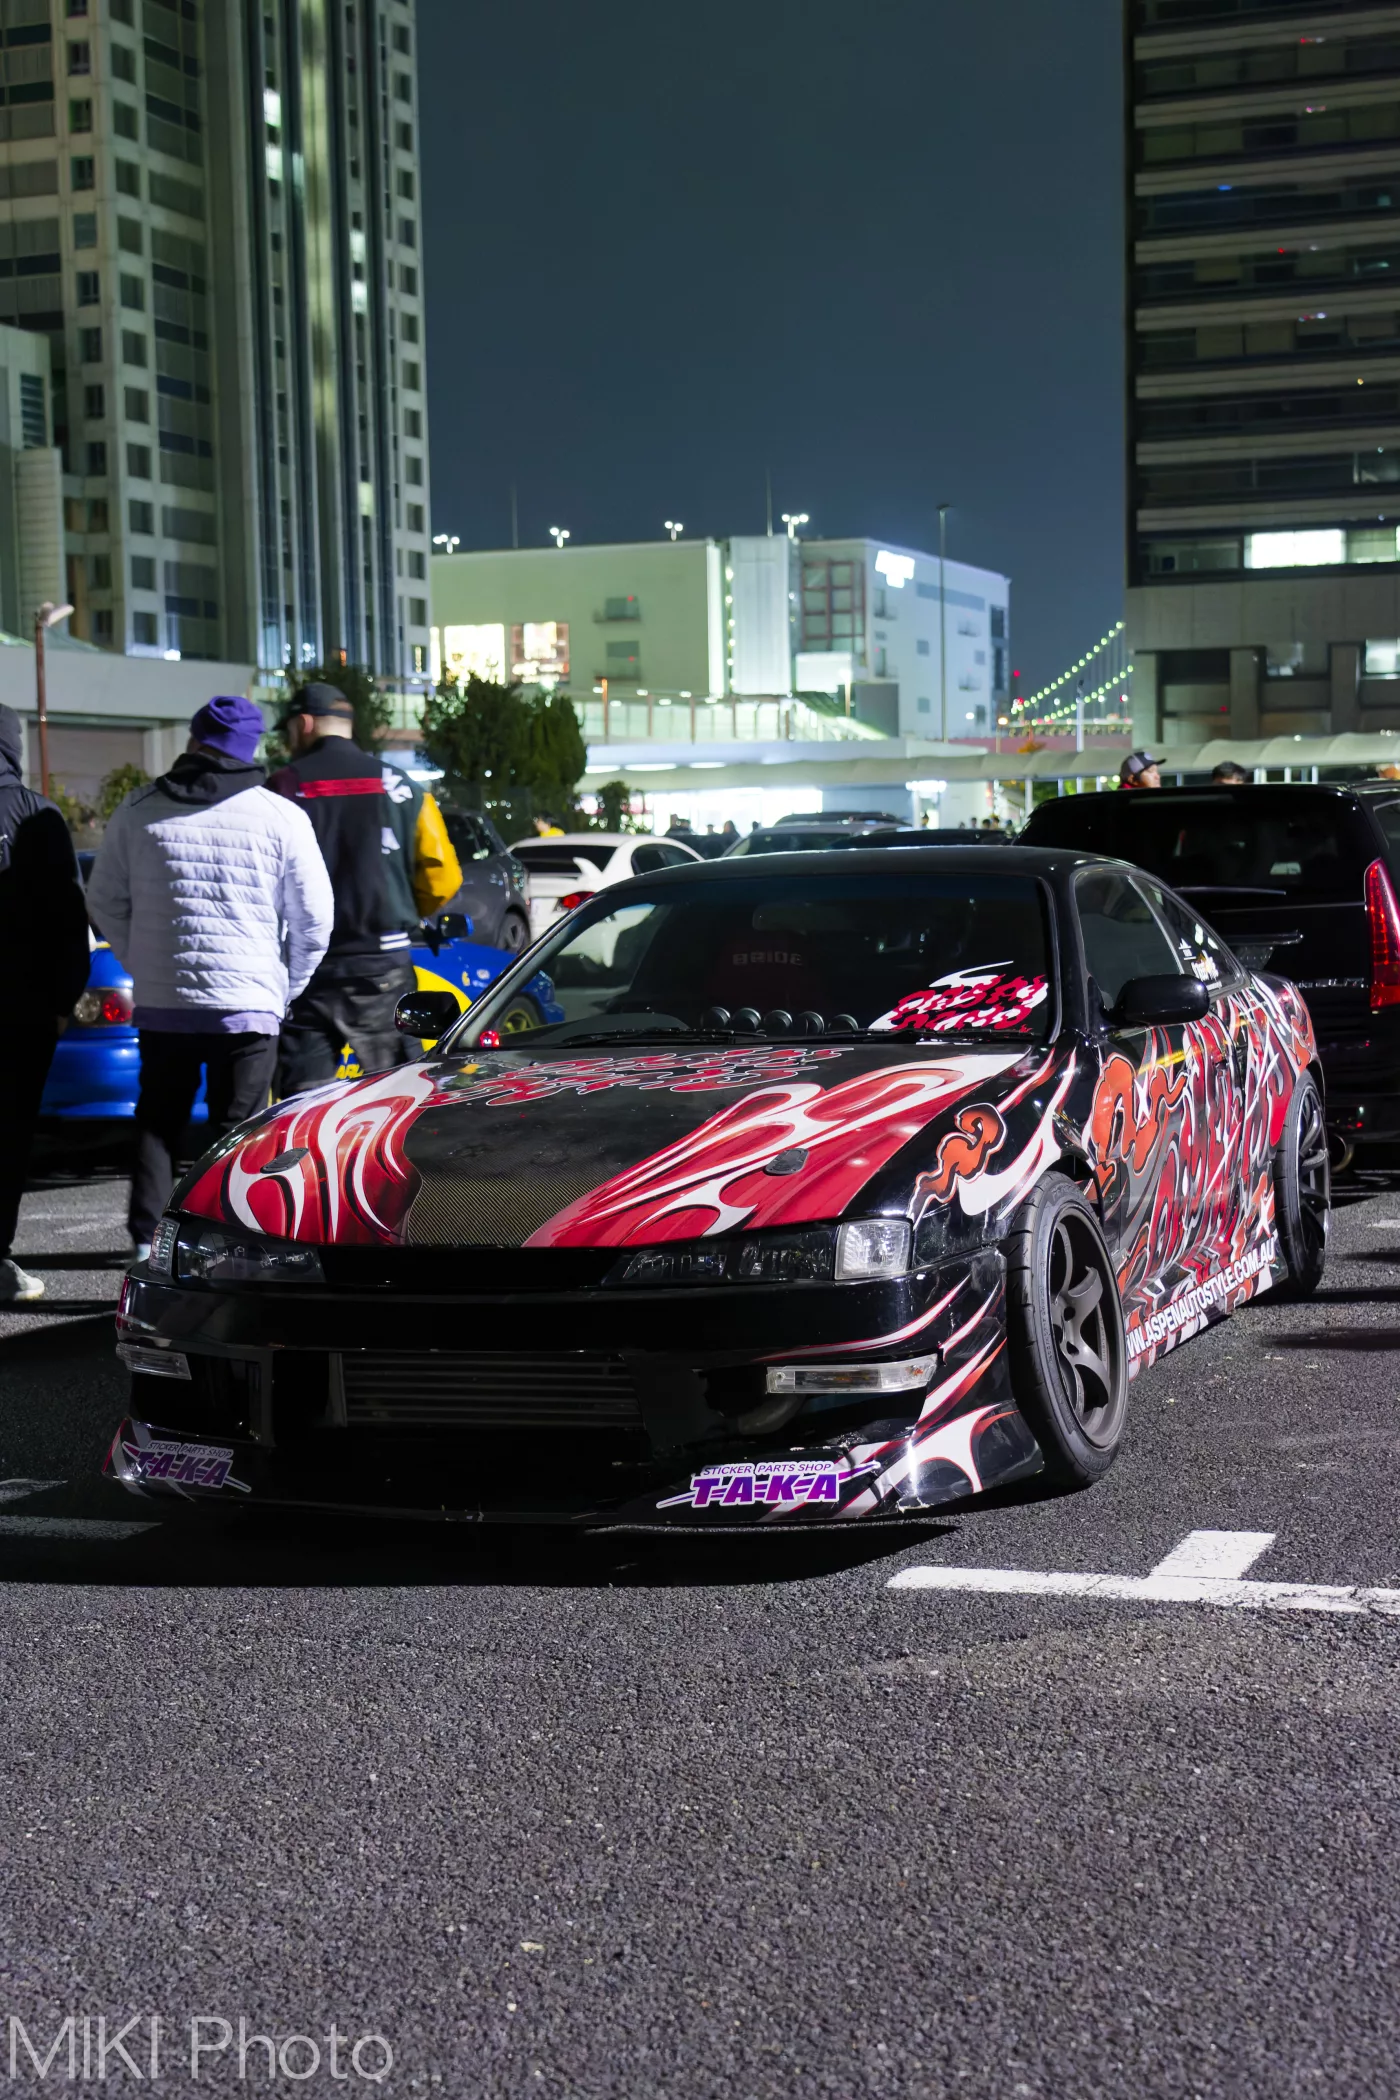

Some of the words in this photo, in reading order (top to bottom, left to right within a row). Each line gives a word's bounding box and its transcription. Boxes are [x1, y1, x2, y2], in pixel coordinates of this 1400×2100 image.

[149, 1442, 179, 1451] STICKER
[179, 1445, 206, 1455] PARTS
[206, 1449, 232, 1459] SHOP
[703, 1465, 752, 1476] STICKER
[756, 1463, 795, 1474] PARTS
[797, 1462, 833, 1473] SHOP
